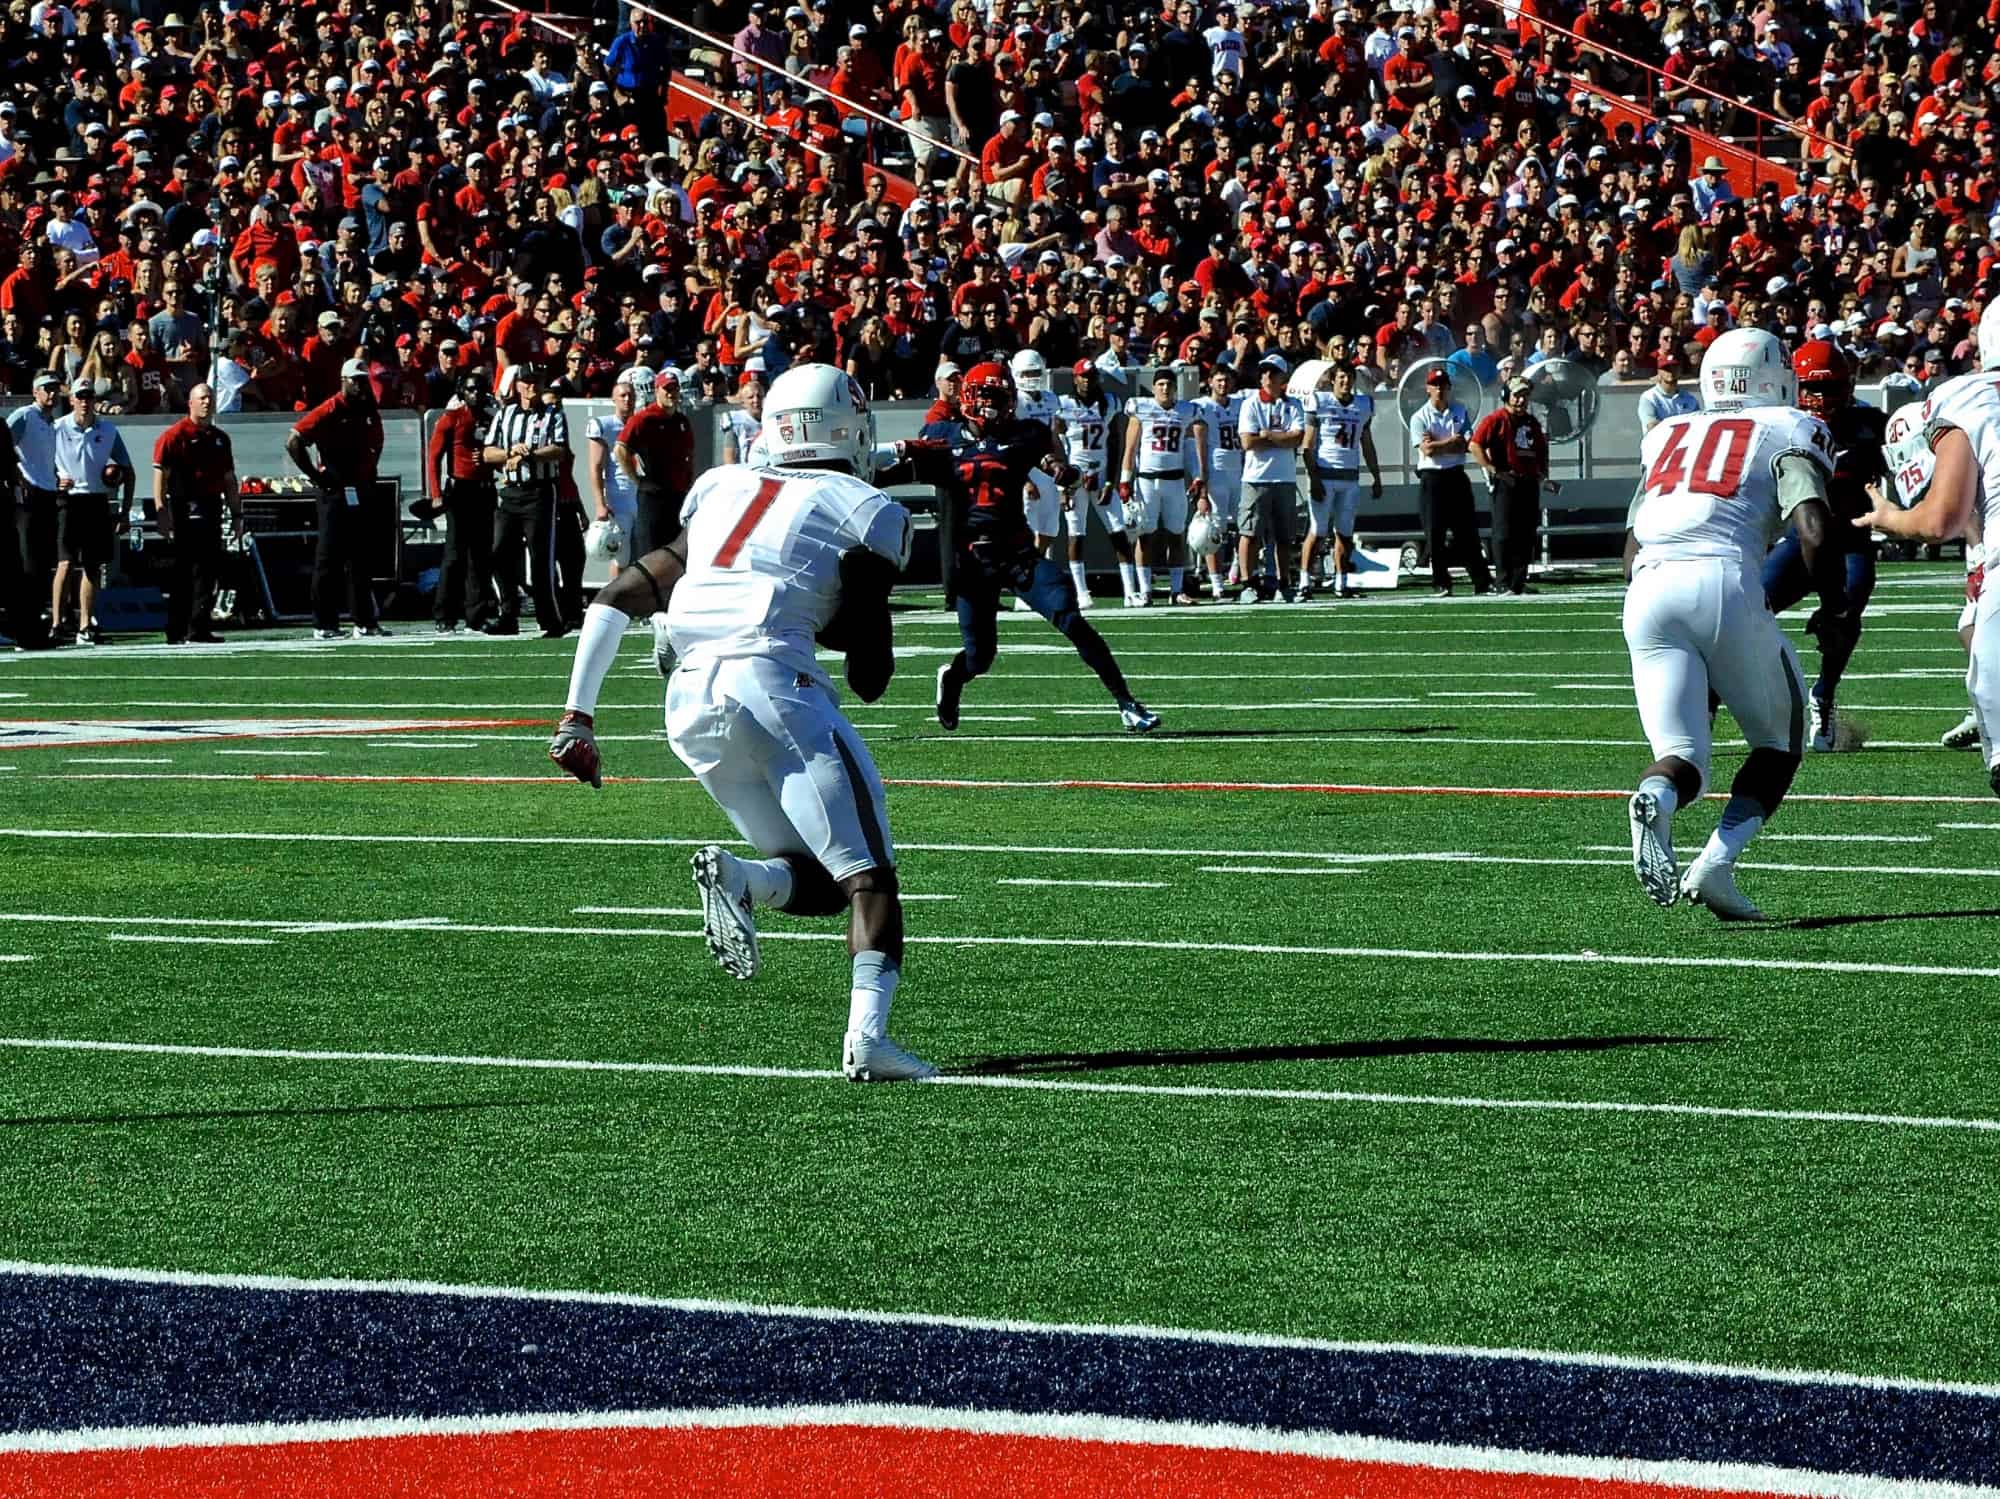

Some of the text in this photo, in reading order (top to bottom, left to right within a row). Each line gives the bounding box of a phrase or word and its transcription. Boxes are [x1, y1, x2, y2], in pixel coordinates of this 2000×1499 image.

[1731, 379, 1746, 393] 40
[1734, 368, 1750, 379] ESF
[802, 423, 808, 442] 1
[1082, 424, 1104, 450] 12
[1152, 425, 1182, 452] 38
[1335, 423, 1357, 448] 41
[1645, 418, 1756, 498] 40
[1900, 462, 1925, 495] 25
[711, 477, 786, 569] 1
